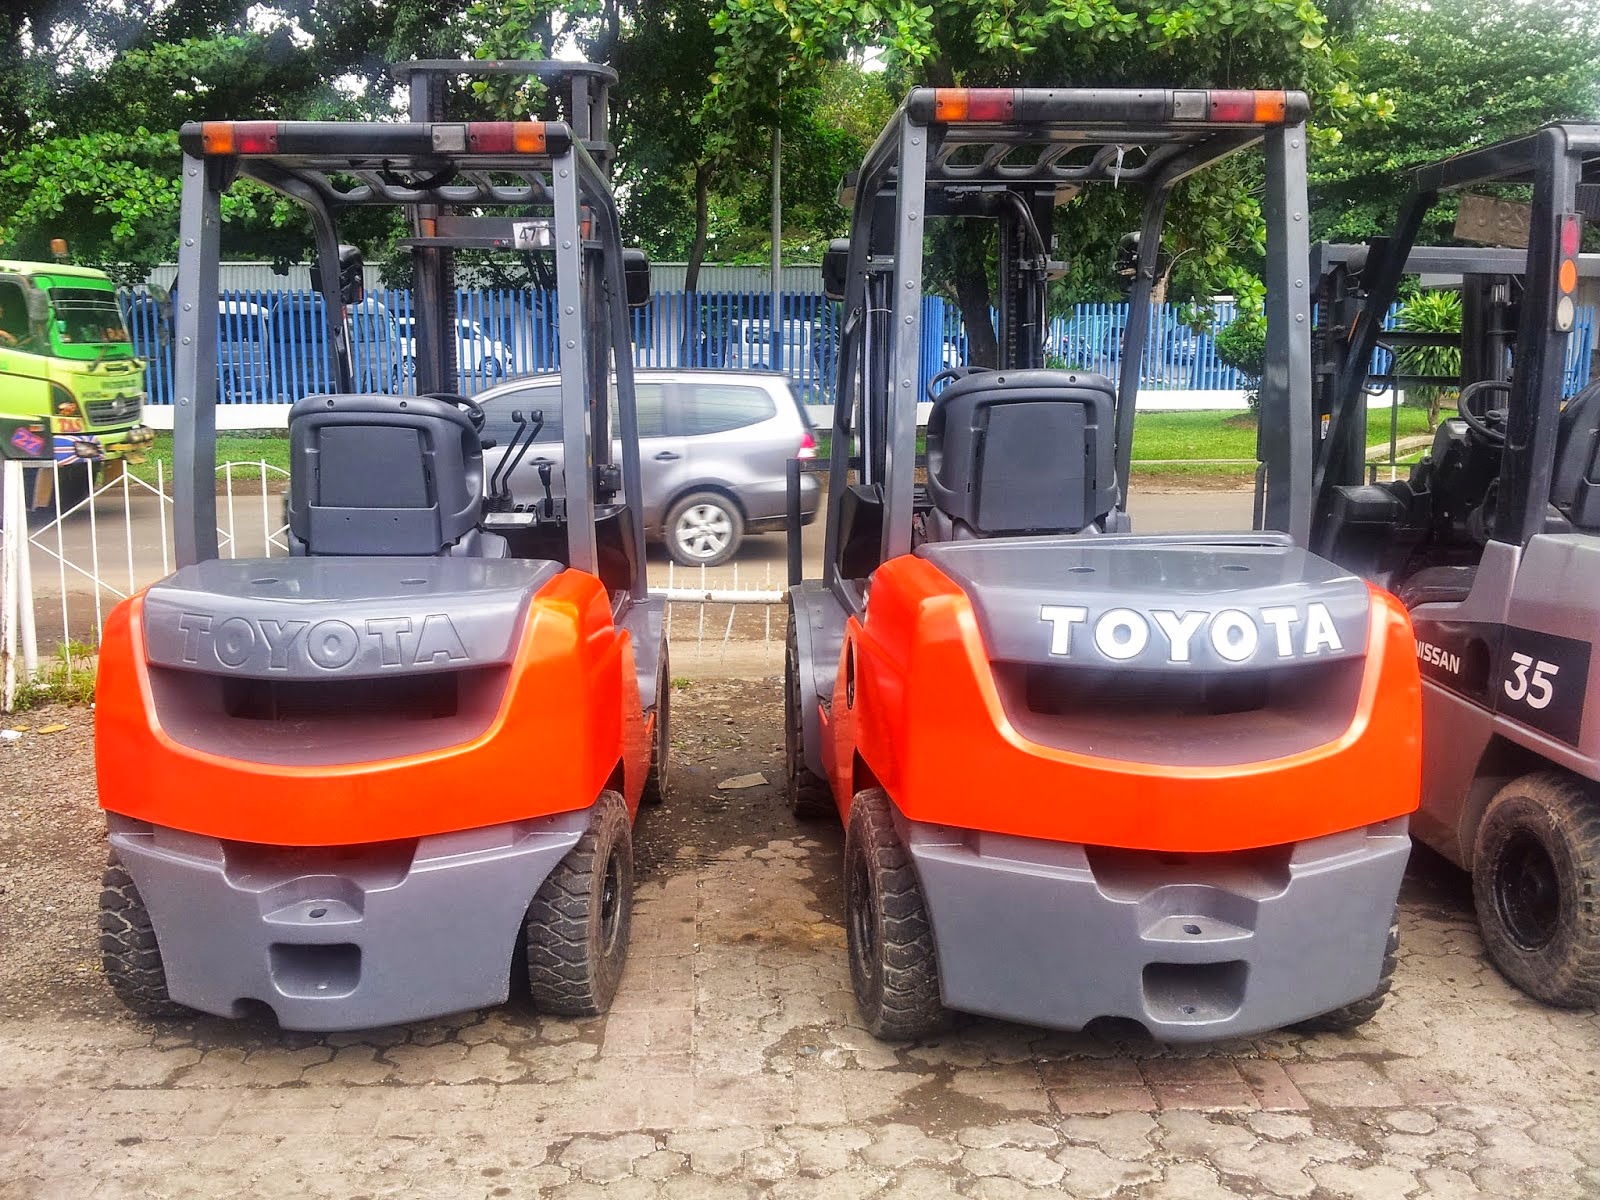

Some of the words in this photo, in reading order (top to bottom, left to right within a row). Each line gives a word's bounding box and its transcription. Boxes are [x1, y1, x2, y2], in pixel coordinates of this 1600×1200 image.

[519, 225, 538, 241] 47
[179, 612, 470, 671] TOYOTA
[1040, 601, 1345, 663] TOYOTA
[1415, 639, 1461, 675] NISSAN
[1504, 651, 1560, 709] 35
